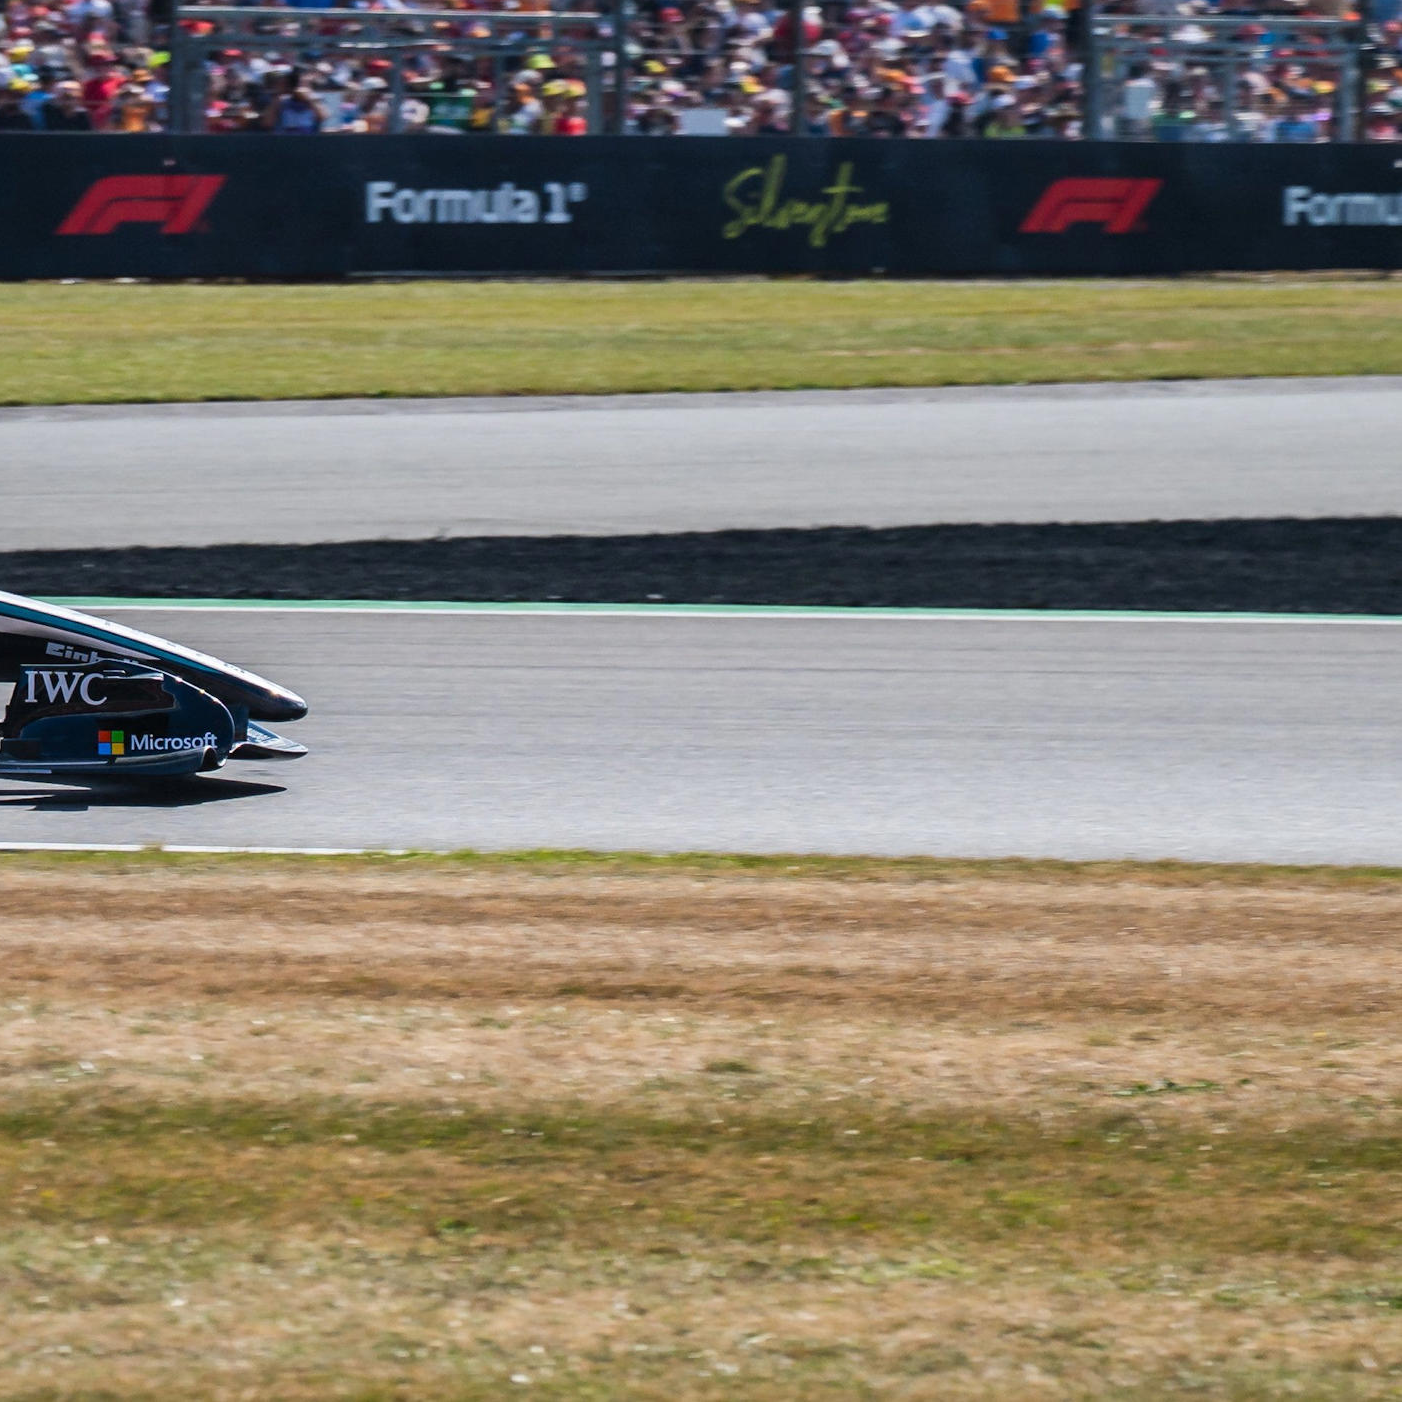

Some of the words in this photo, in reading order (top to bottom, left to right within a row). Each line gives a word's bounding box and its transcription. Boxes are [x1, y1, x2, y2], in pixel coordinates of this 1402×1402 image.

[366, 180, 541, 224] Formula
[24, 670, 107, 706] IWC
[130, 731, 218, 751] Microsoft
